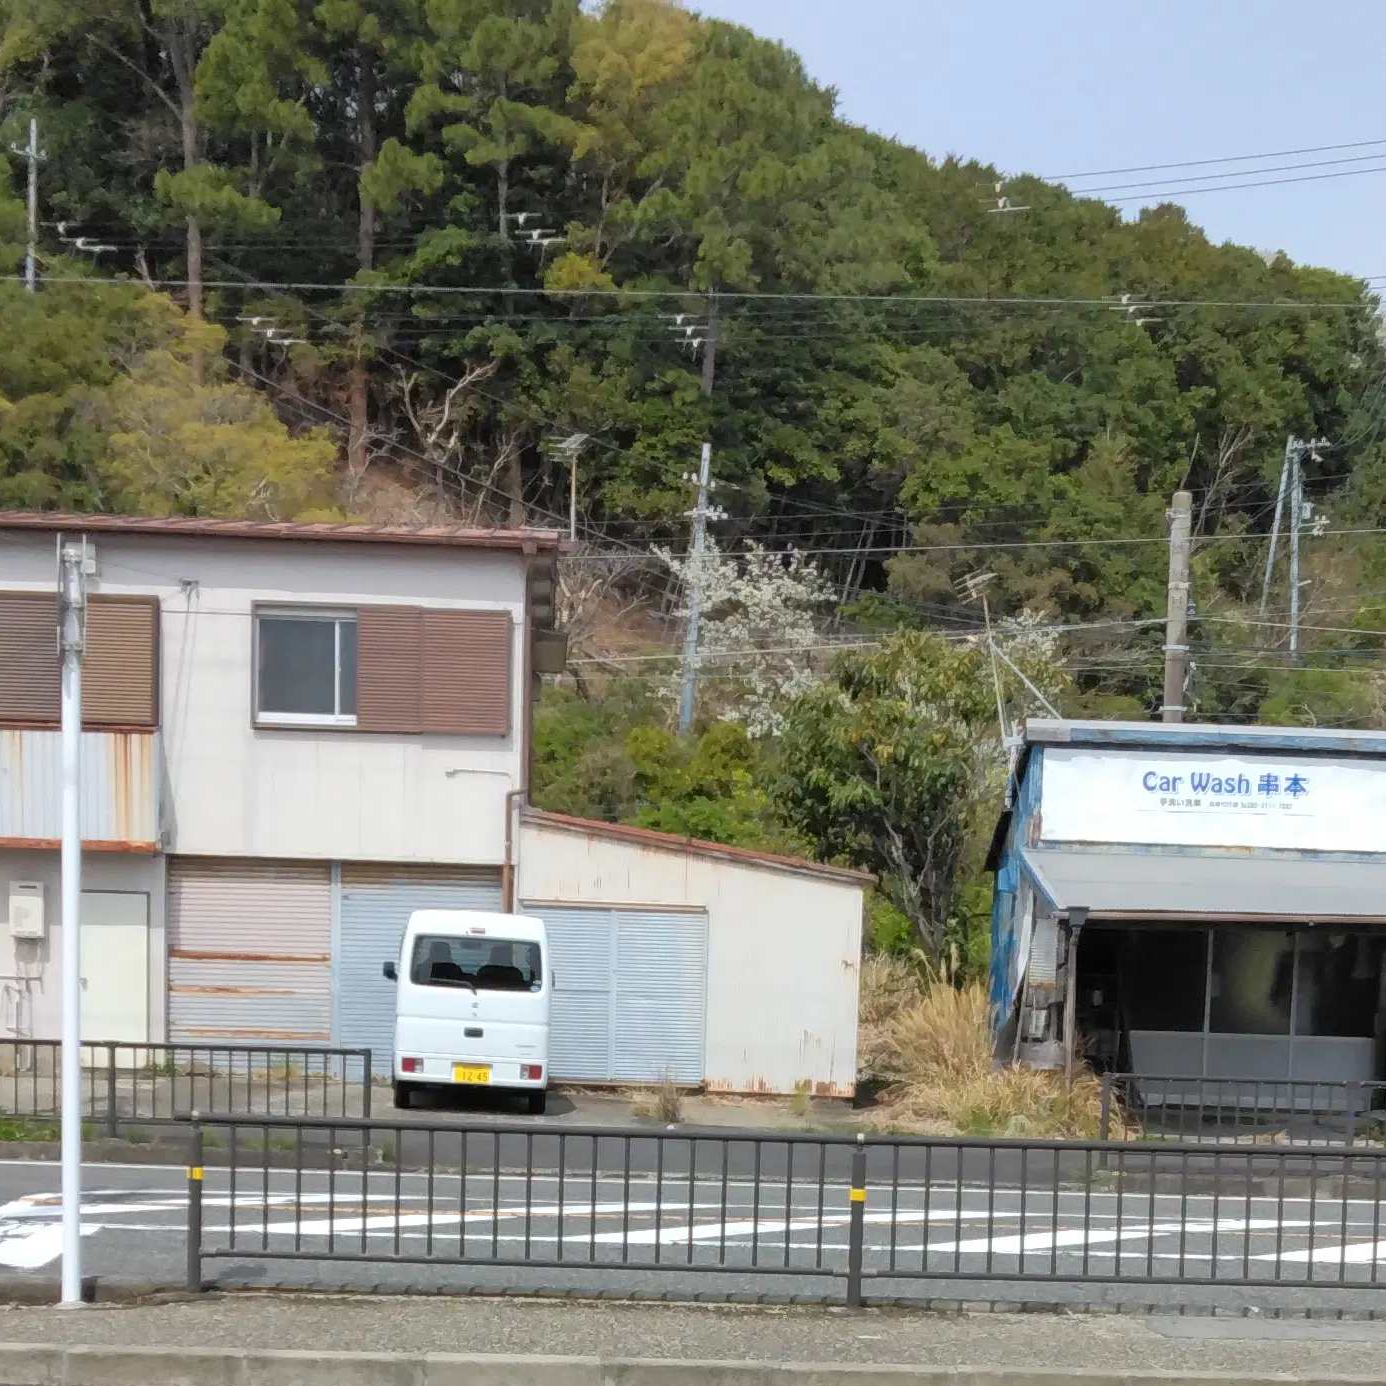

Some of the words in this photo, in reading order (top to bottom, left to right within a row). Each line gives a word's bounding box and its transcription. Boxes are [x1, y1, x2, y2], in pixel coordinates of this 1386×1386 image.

[1142, 771, 1183, 793] Car
[1190, 772, 1251, 794] Wash
[1257, 773, 1309, 797] 串本
